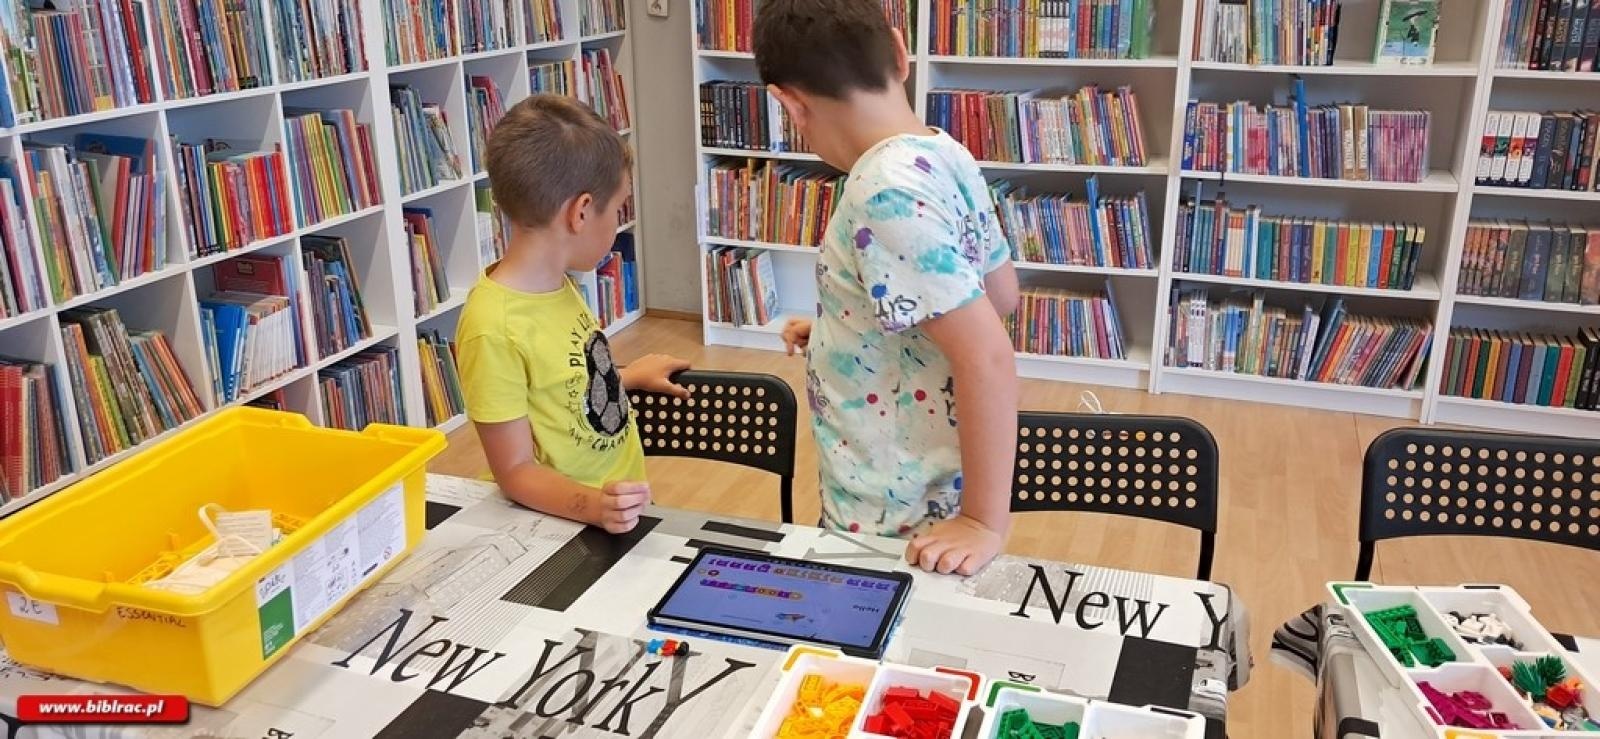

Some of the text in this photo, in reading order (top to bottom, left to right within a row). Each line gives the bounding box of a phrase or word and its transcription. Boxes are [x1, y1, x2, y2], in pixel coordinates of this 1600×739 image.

[116, 606, 187, 628] ESSENTIAL
[1009, 563, 1170, 639] New
[331, 608, 670, 737] New York
